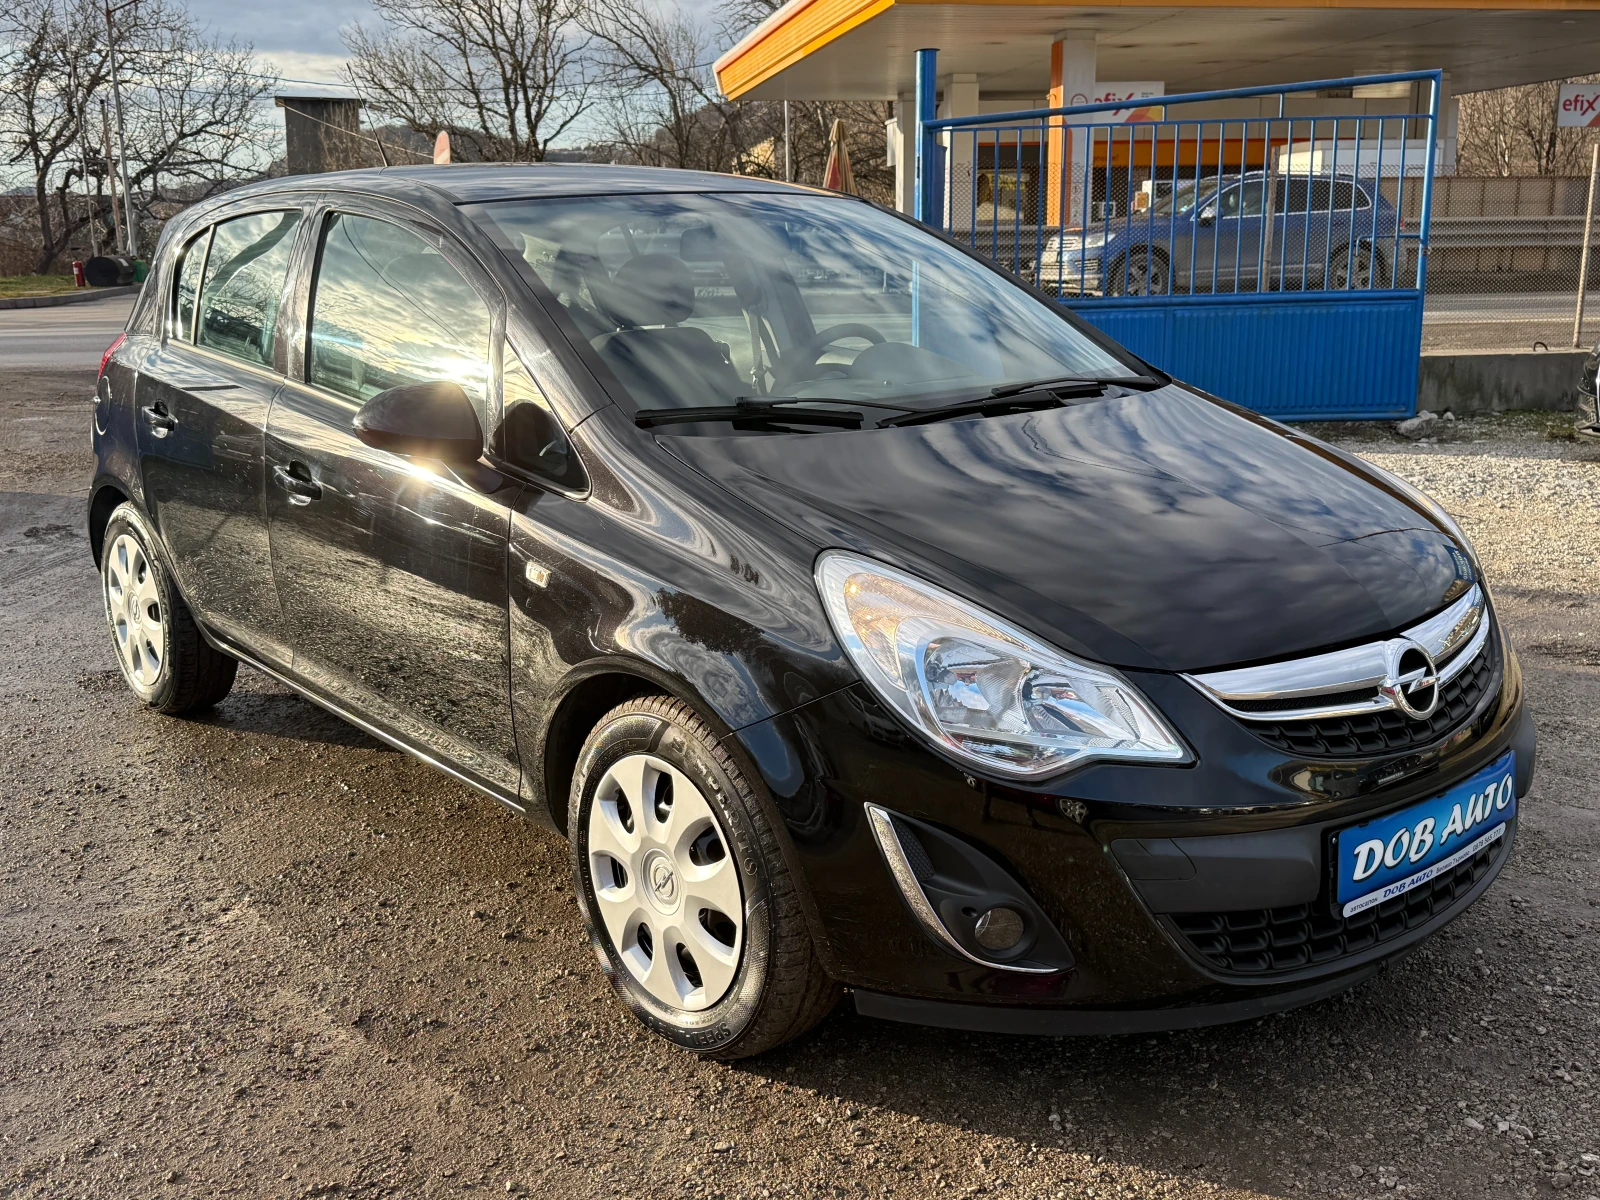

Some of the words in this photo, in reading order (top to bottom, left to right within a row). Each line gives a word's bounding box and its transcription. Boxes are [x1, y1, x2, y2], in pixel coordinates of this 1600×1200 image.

[1562, 94, 1600, 117] efix
[1352, 817, 1436, 882] DOB
[1439, 772, 1513, 845] AUTO
[1383, 882, 1407, 898] DOB
[1408, 869, 1433, 887] AUTO
